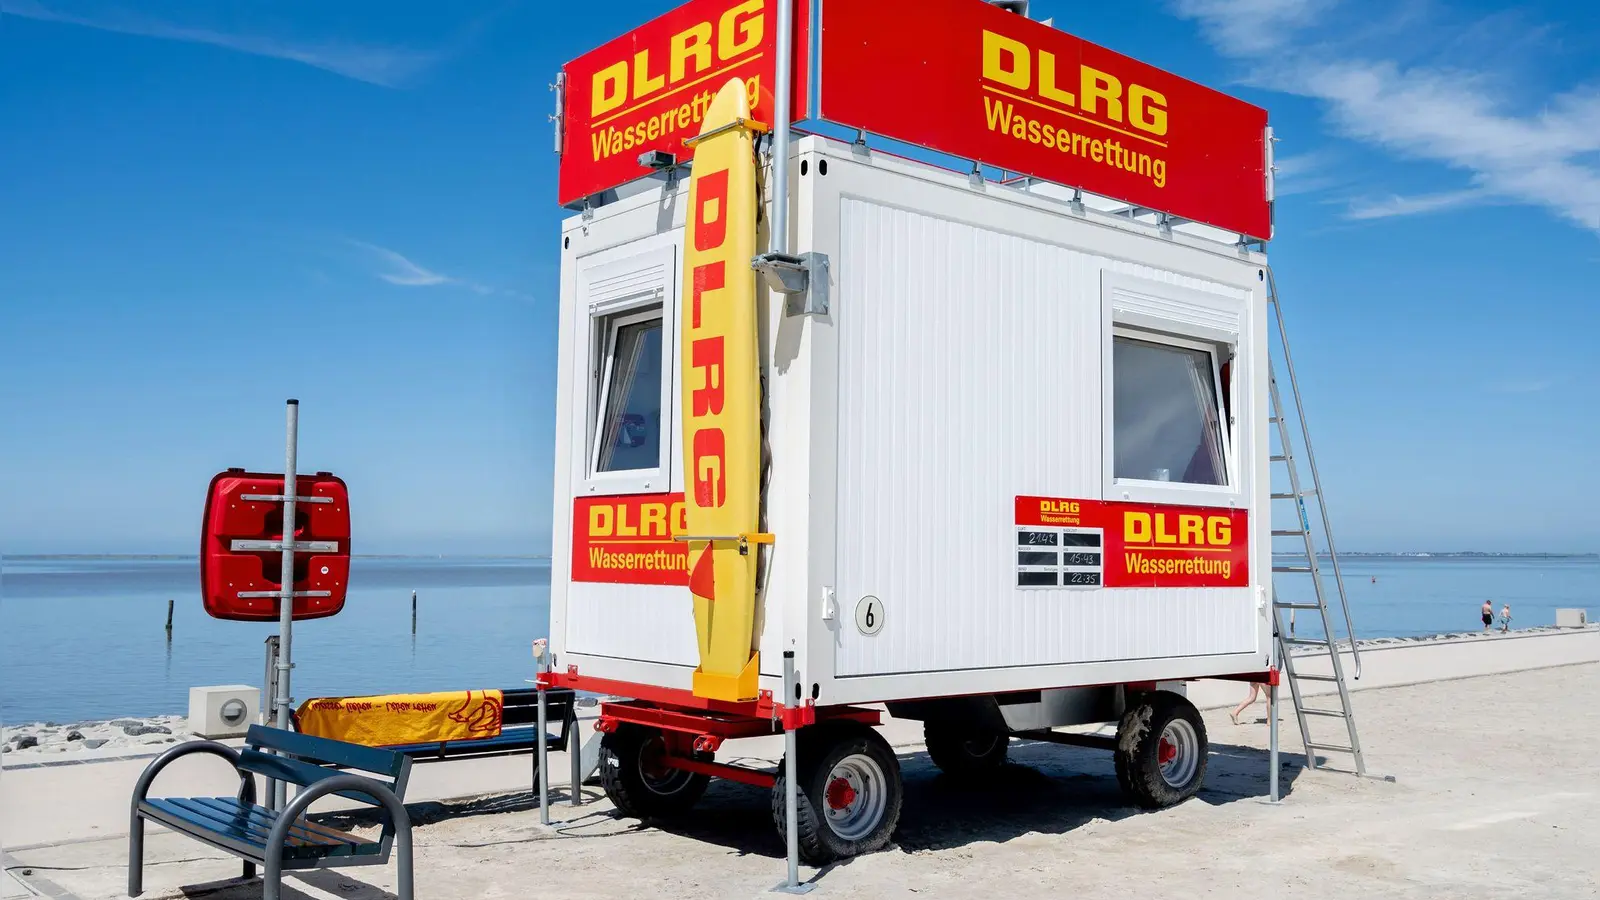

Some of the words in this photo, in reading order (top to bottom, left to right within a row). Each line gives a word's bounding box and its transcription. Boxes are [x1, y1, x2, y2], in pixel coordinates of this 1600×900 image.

[591, 0, 764, 118] DLRG
[983, 29, 1167, 136] DLRG
[591, 74, 760, 162] Wasserrettg
[984, 96, 1166, 188] Wasserrettung
[692, 168, 729, 508] DLRG
[1040, 501, 1080, 513] DLRG
[1040, 514, 1080, 525] Wasserrettung
[1124, 511, 1232, 545] DLRG
[1125, 552, 1232, 579] Wasserrettung
[866, 602, 875, 628] 6
